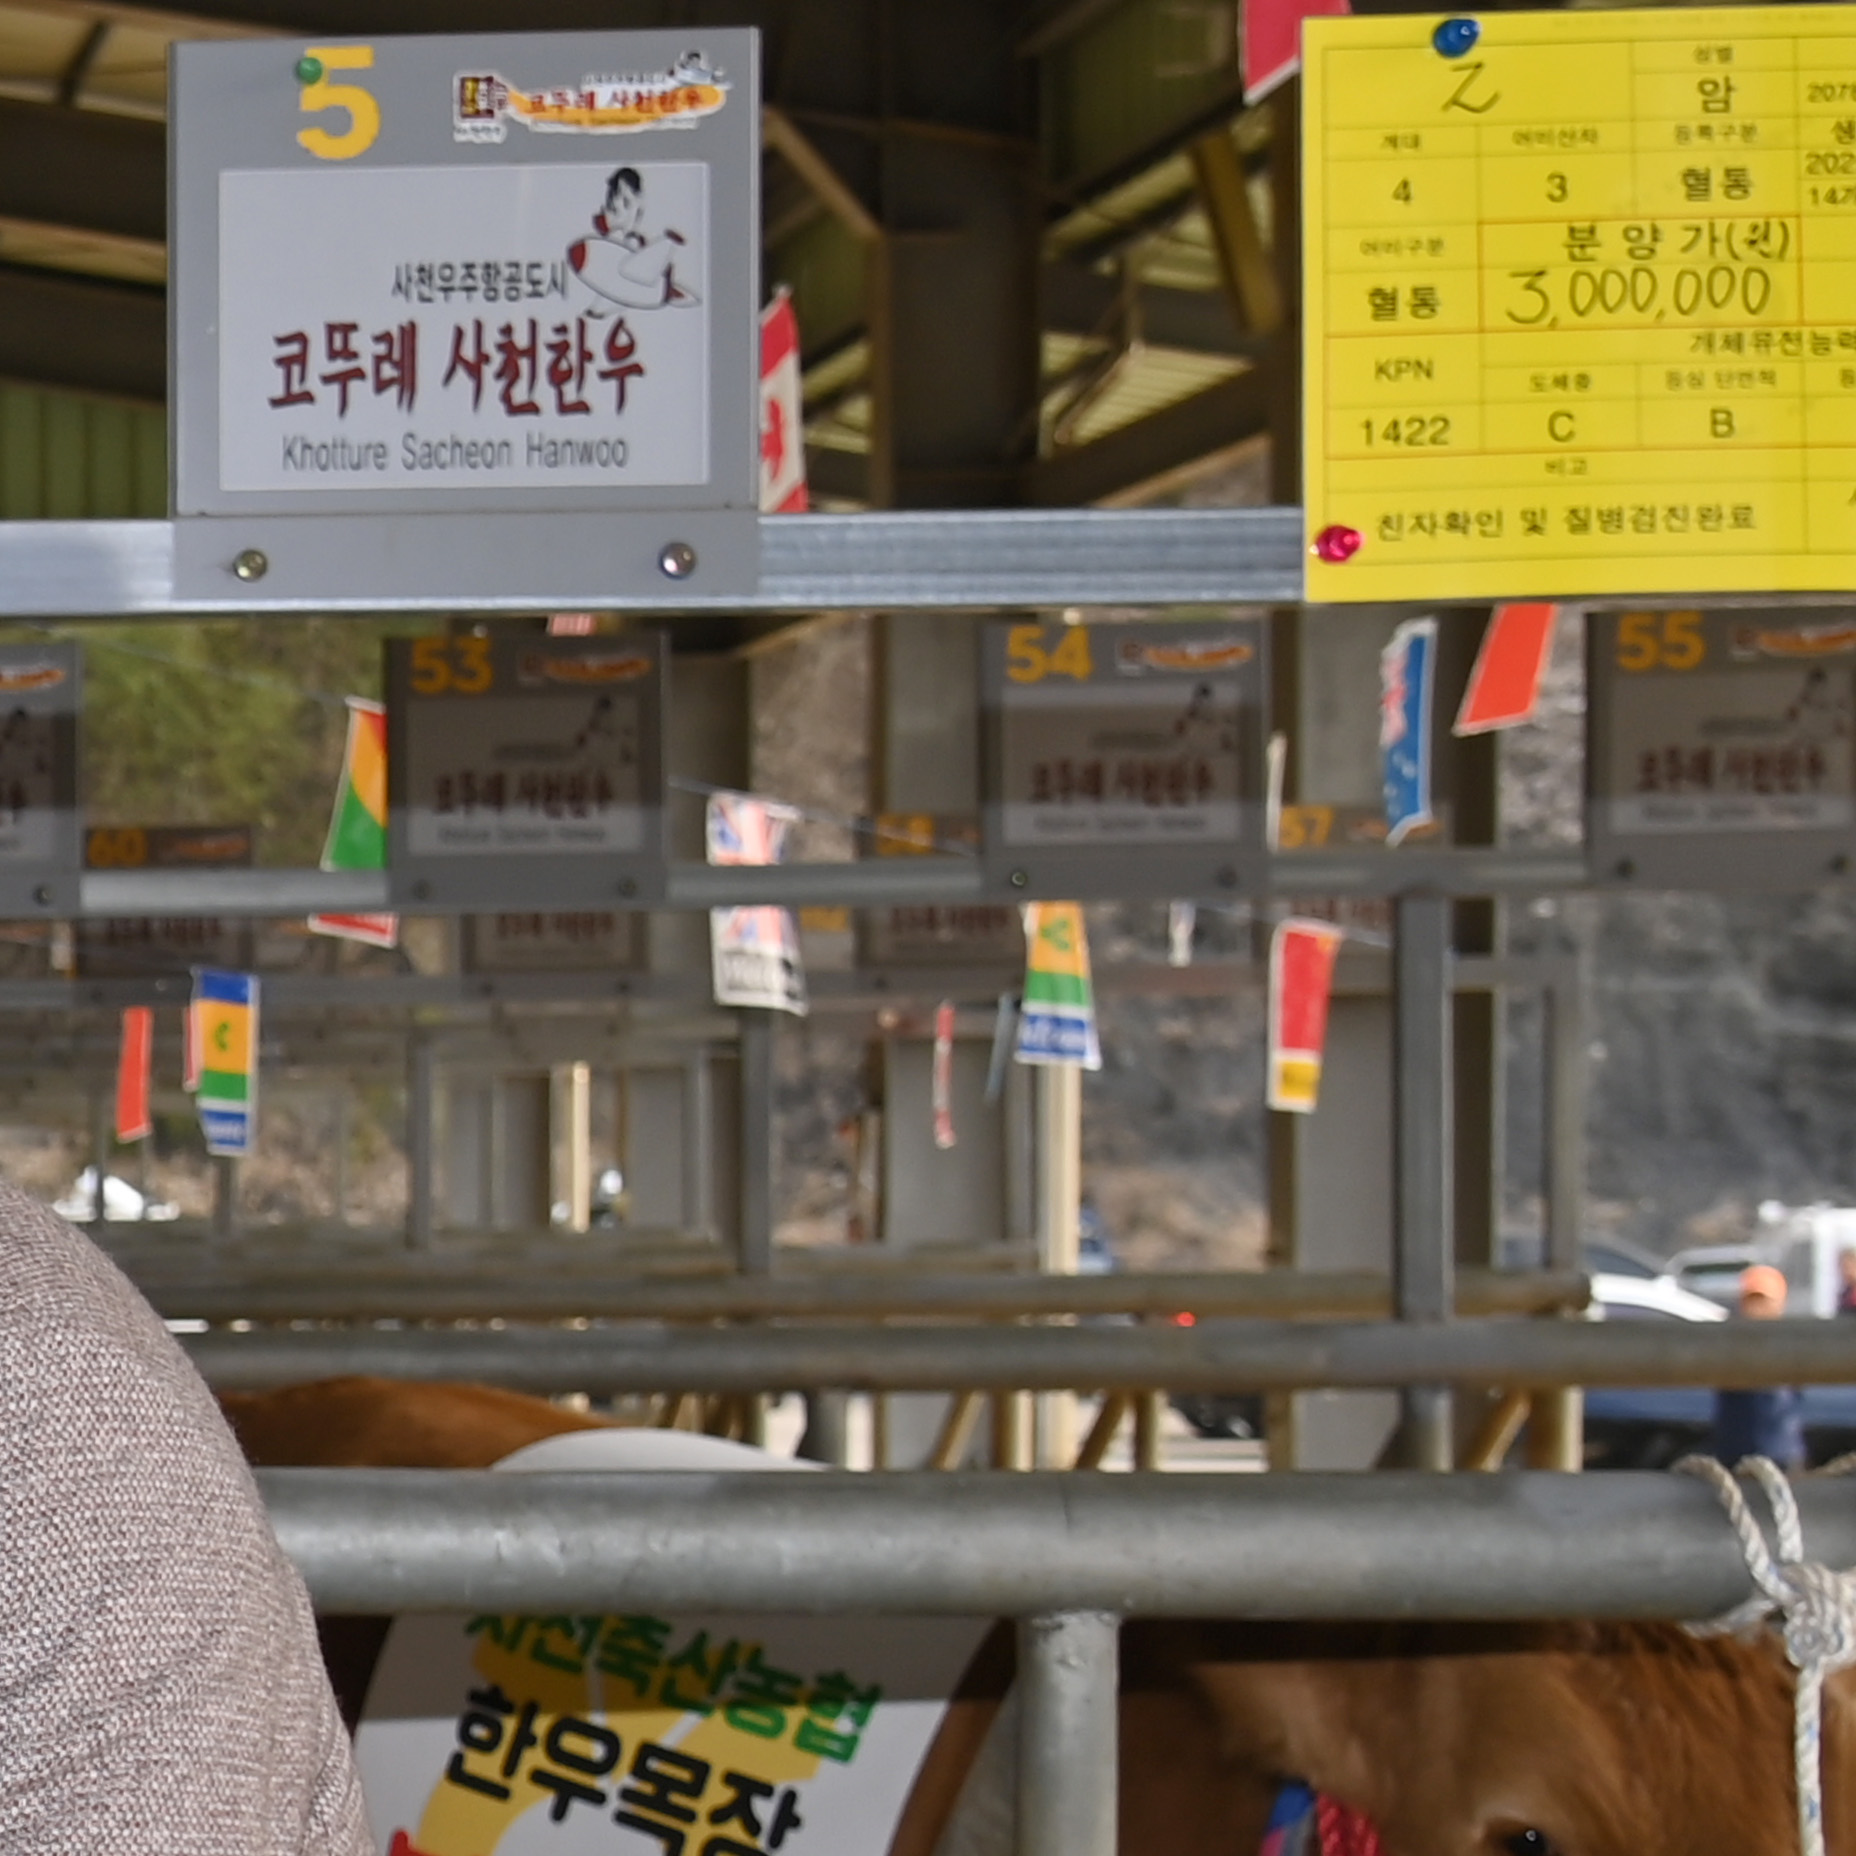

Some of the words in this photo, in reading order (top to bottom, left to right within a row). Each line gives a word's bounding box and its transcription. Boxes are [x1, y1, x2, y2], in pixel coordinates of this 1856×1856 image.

[296, 45, 382, 160] 5
[1697, 75, 1736, 114] 암
[1392, 177, 1412, 205] 4
[1546, 172, 1568, 203] 3
[391, 260, 567, 303] 사천우주항공도시
[1506, 266, 1770, 329] 3,000,000
[267, 320, 418, 419] 코뚜레
[441, 317, 645, 416] 사천한우
[1375, 359, 1434, 382] KPN
[1359, 415, 1451, 448] 1422
[1547, 410, 1576, 443] C
[1709, 407, 1736, 439] B
[282, 433, 387, 473] Khotture
[401, 431, 512, 470] Sacheon
[526, 430, 629, 468] Hanwoo
[1377, 509, 1504, 542] 친자확인
[1521, 508, 1548, 536] 및
[1564, 504, 1757, 535] 질병검진완료
[1008, 625, 1095, 683] 54
[1618, 610, 1705, 671] 55
[411, 637, 493, 694] 53
